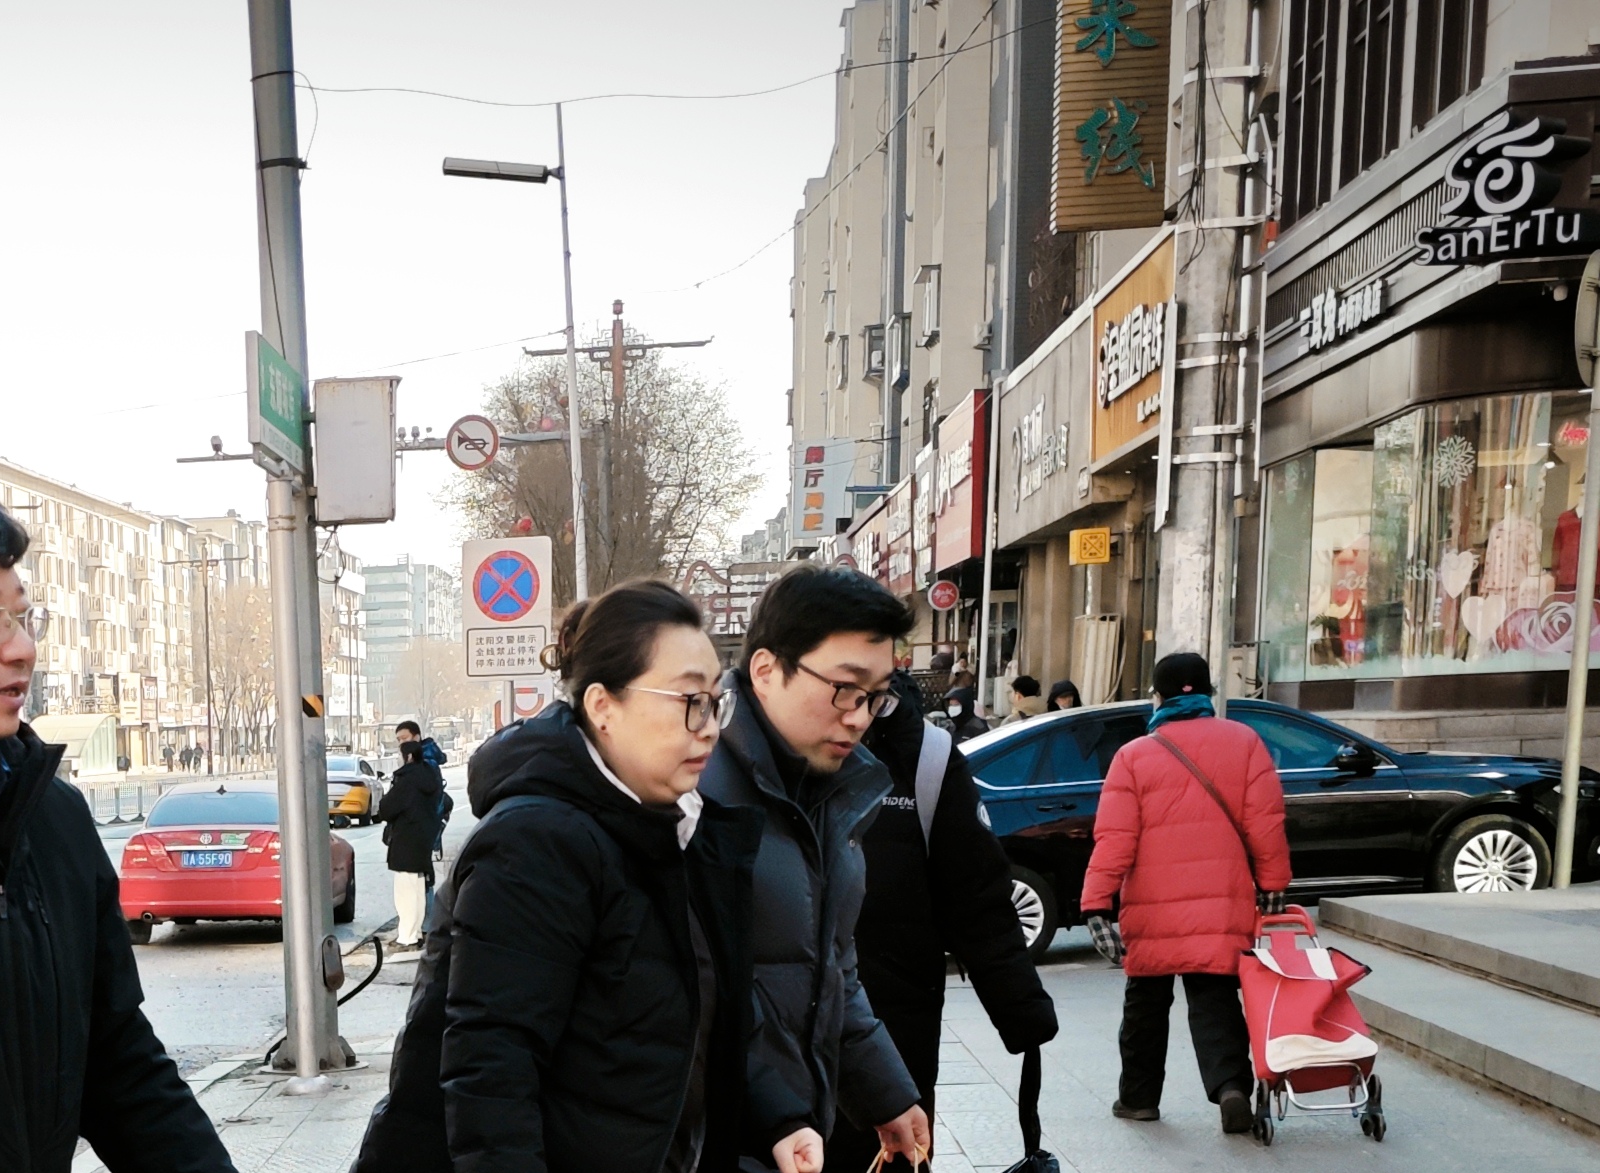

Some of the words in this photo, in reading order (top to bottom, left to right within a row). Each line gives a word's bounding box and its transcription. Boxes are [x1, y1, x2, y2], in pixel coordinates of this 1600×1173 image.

[1414, 207, 1580, 266] SanErTu
[475, 634, 537, 646] 沈阳交警提示
[475, 645, 537, 657] 全线禁止停车
[475, 657, 537, 668] 停车泊位除外
